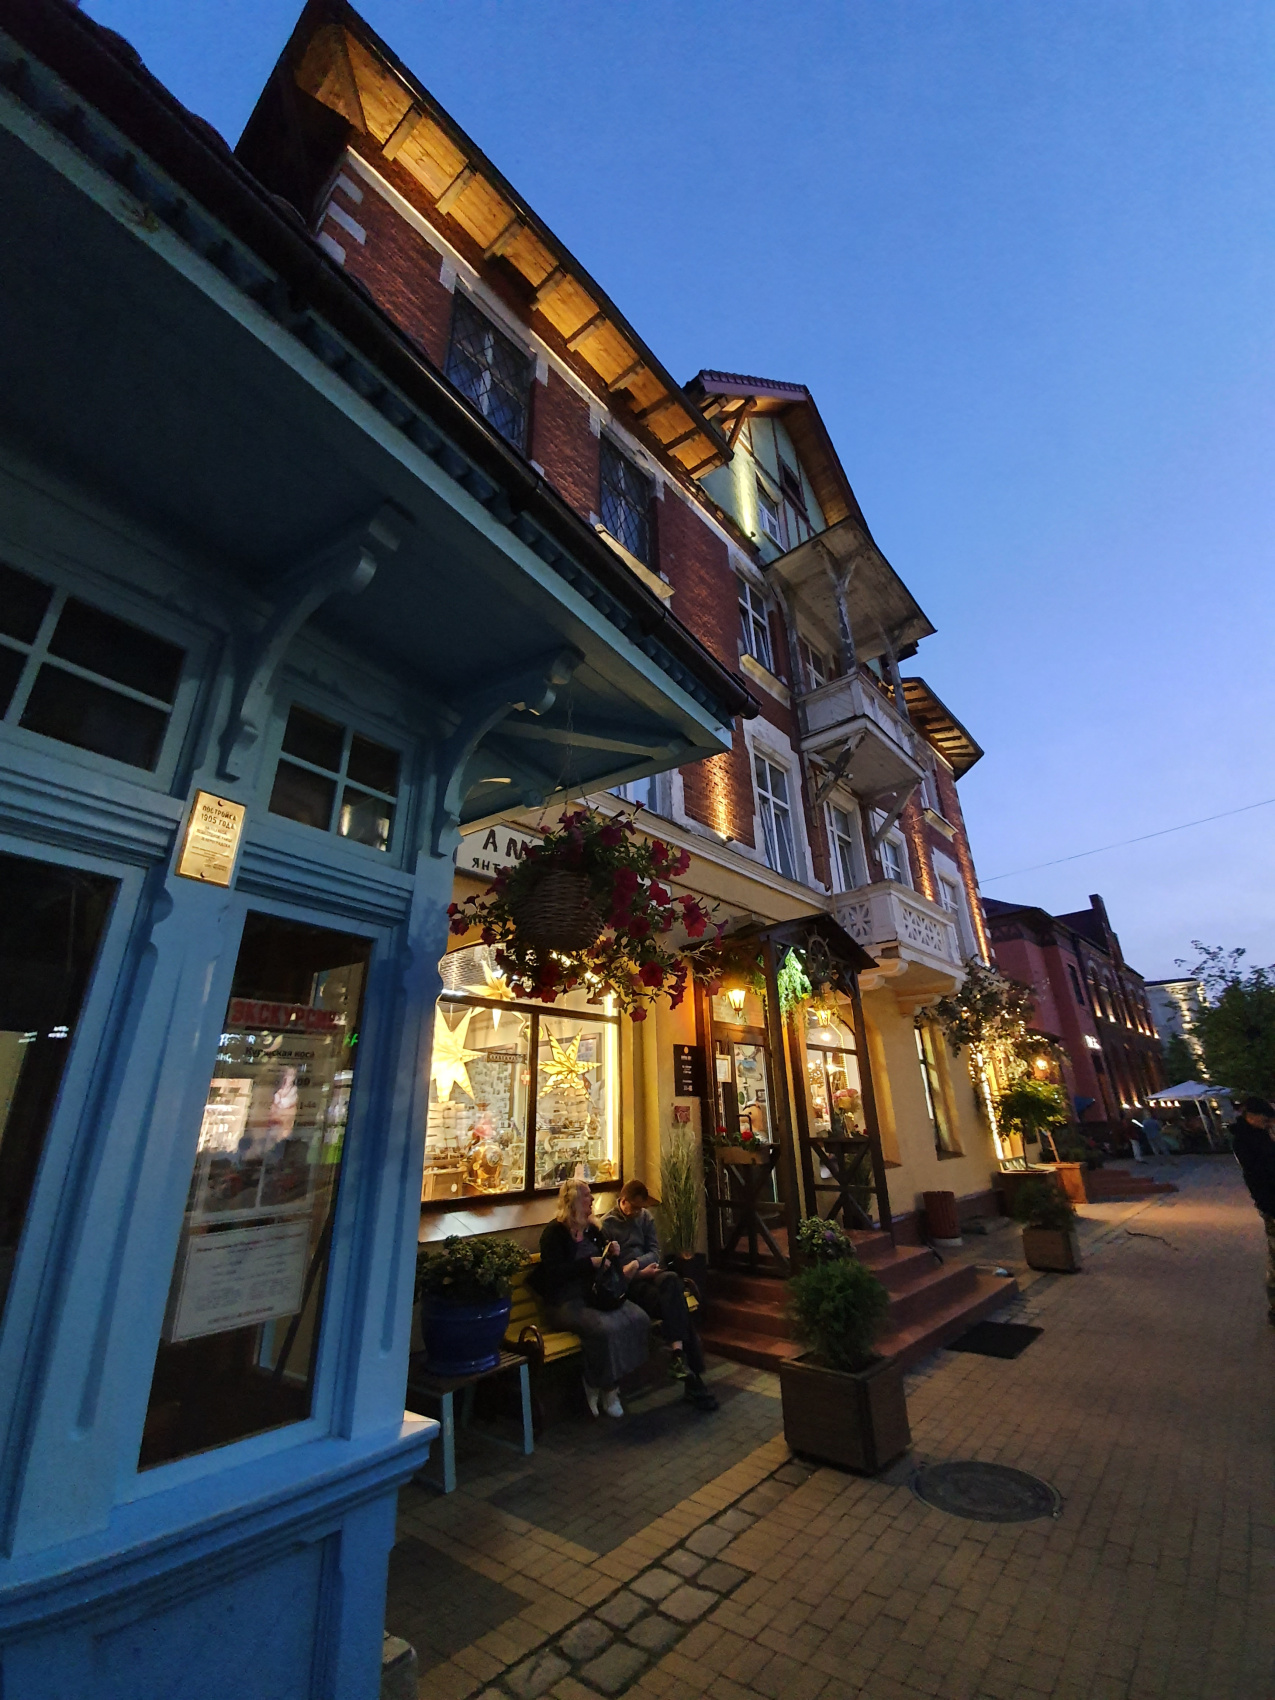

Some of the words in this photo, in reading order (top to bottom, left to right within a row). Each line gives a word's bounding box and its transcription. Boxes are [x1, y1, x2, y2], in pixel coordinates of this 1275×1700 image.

[202, 805, 236, 821] ПОСТРОЙКА
[201, 813, 217, 824] 1905
[218, 819, 236, 830] ГОДА
